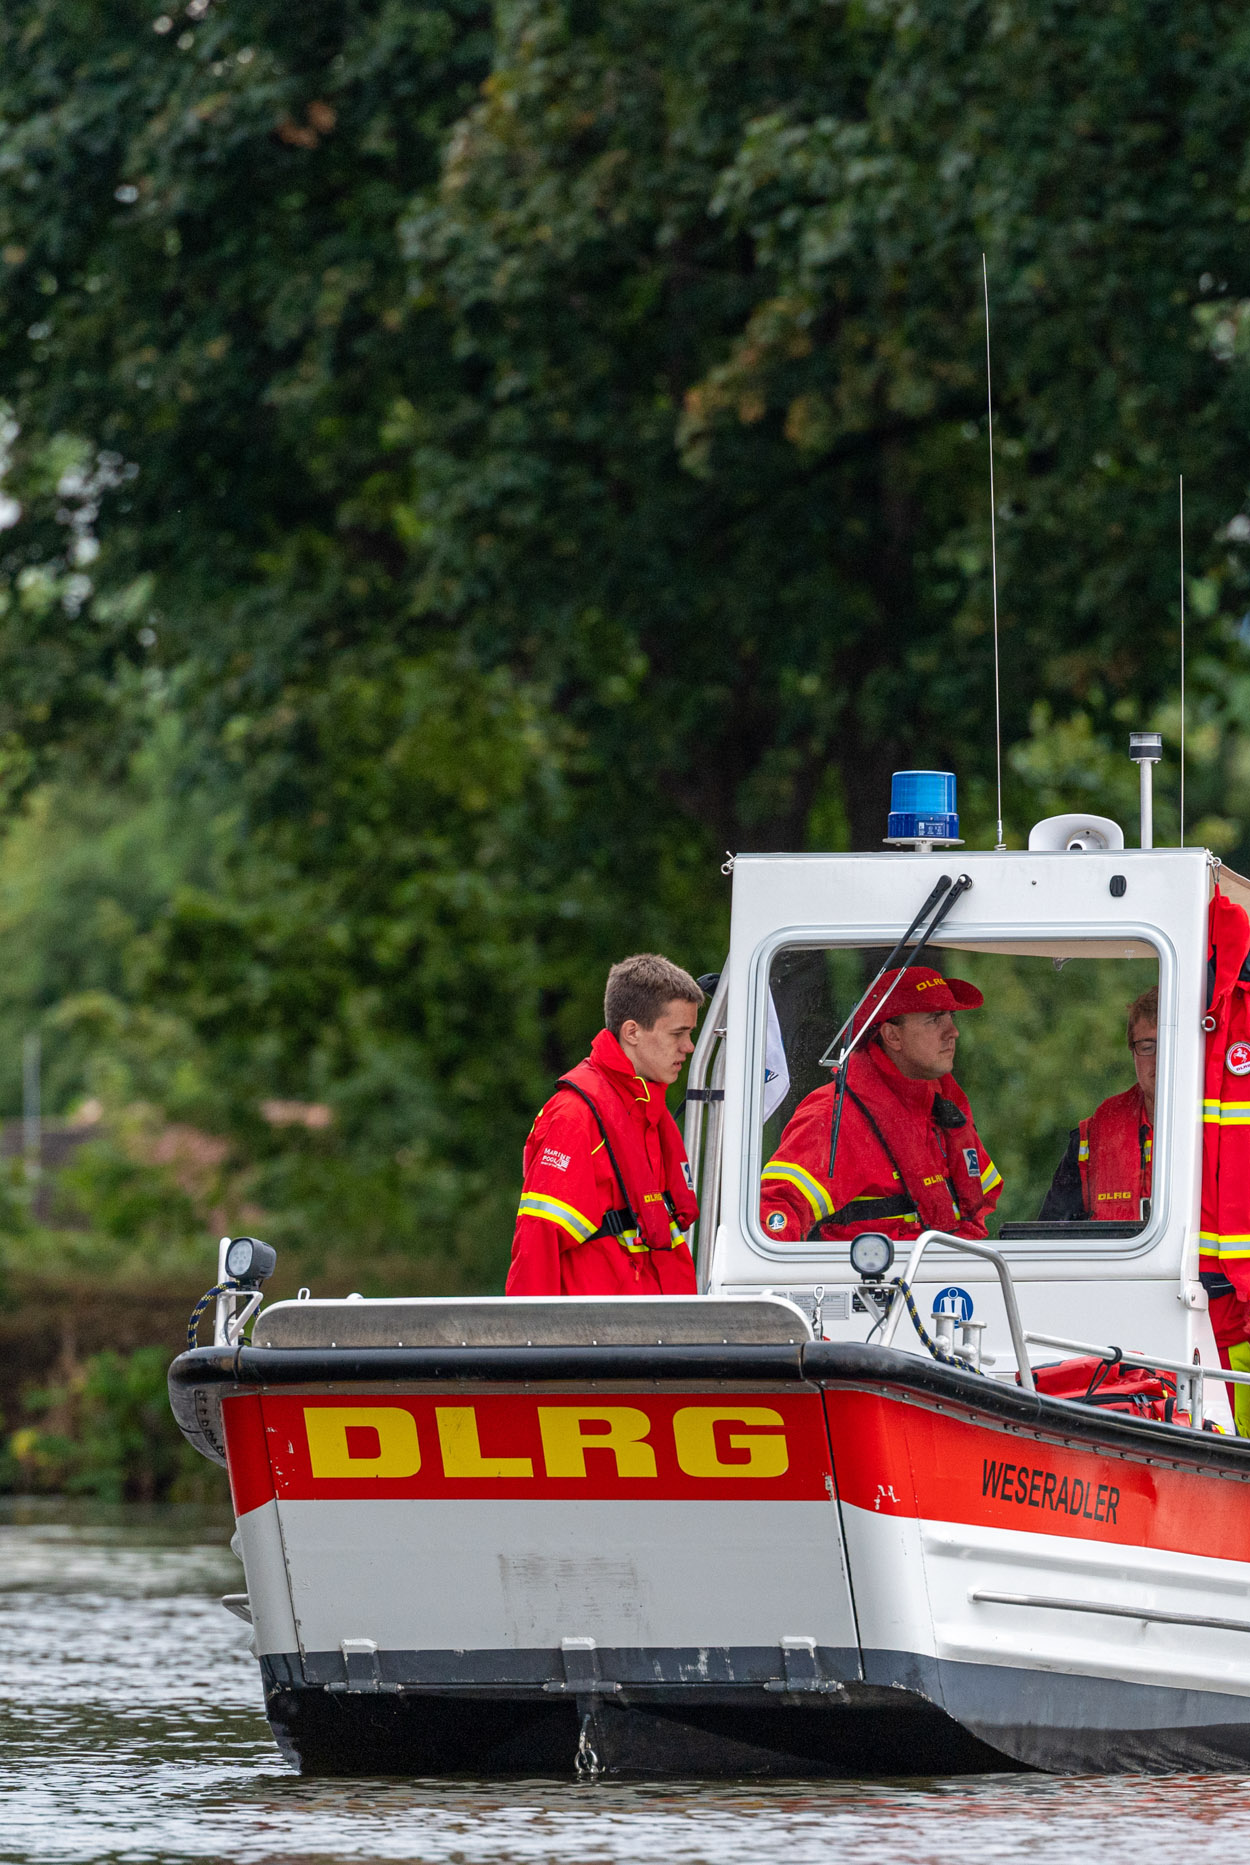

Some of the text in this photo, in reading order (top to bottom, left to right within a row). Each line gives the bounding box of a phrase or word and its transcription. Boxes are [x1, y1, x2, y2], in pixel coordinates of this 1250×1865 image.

[543, 1147, 571, 1161] MARINE
[1097, 1191, 1132, 1201] DLRG
[302, 1406, 790, 1479] DLRG
[982, 1458, 1121, 1525] WESERADLER
